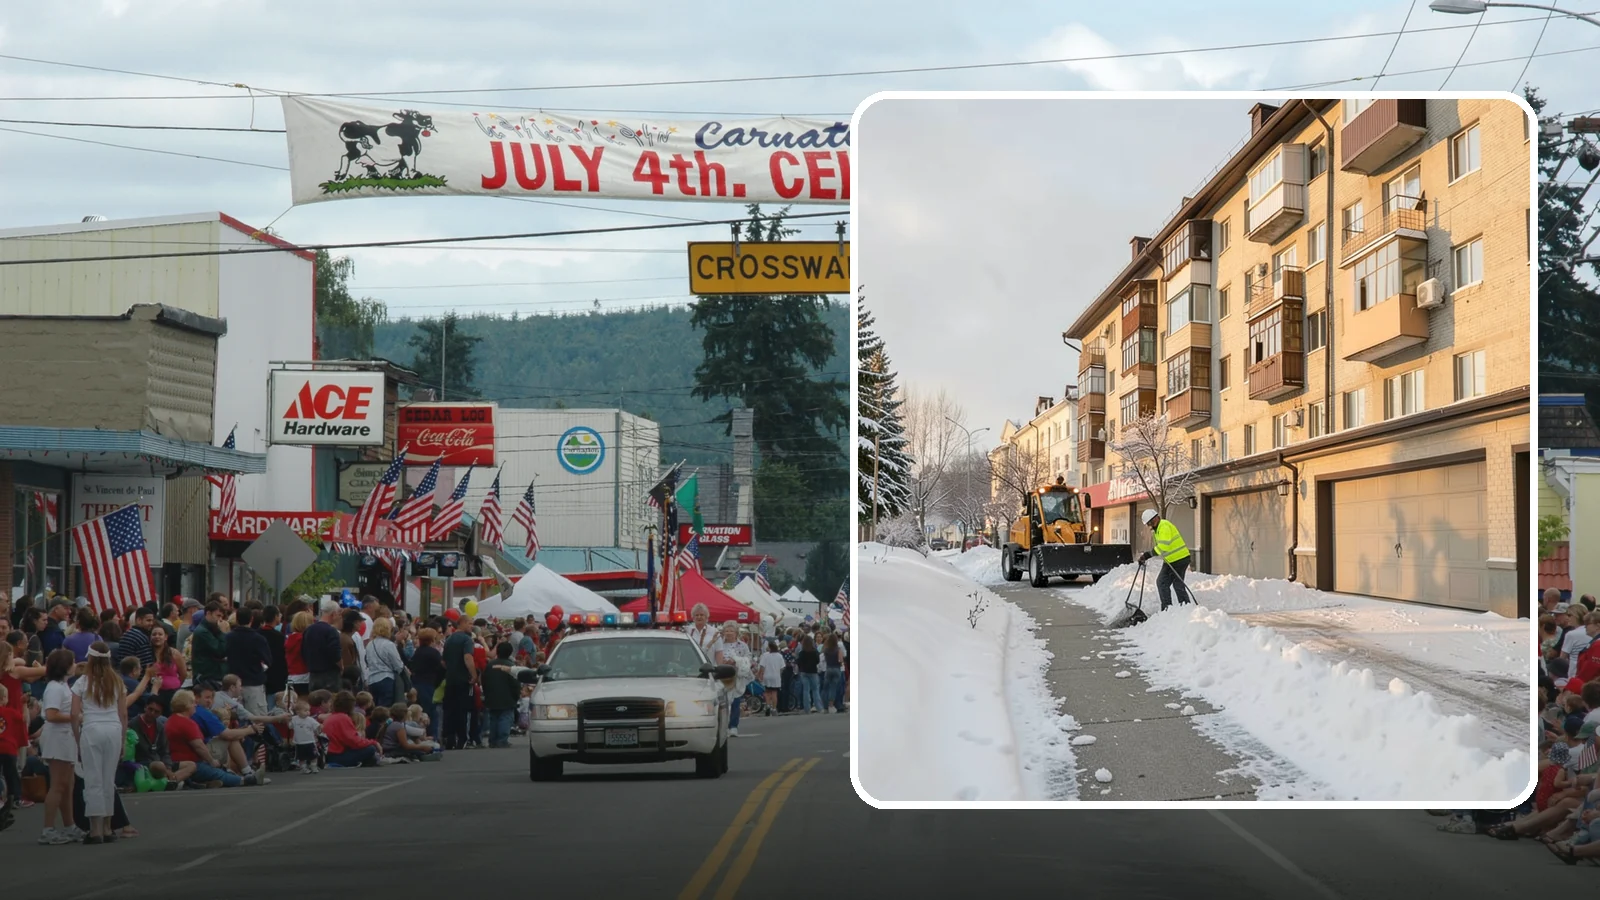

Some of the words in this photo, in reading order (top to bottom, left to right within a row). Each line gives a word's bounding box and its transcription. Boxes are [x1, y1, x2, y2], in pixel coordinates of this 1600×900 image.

[481, 141, 604, 193] JULY
[632, 150, 746, 199] 4th.
[697, 254, 850, 280] CROSSWA
[283, 380, 373, 420] ACE
[405, 408, 452, 422] CEDAR
[461, 409, 485, 421] LOG
[283, 421, 371, 437] Hardware
[416, 428, 477, 447] Coca-Cola
[353, 467, 385, 479] Simpl
[95, 485, 124, 494] Vincent
[126, 486, 136, 494] de
[137, 486, 155, 495] Paul
[688, 526, 741, 535] CRNATION
[699, 535, 730, 543] GLASS
